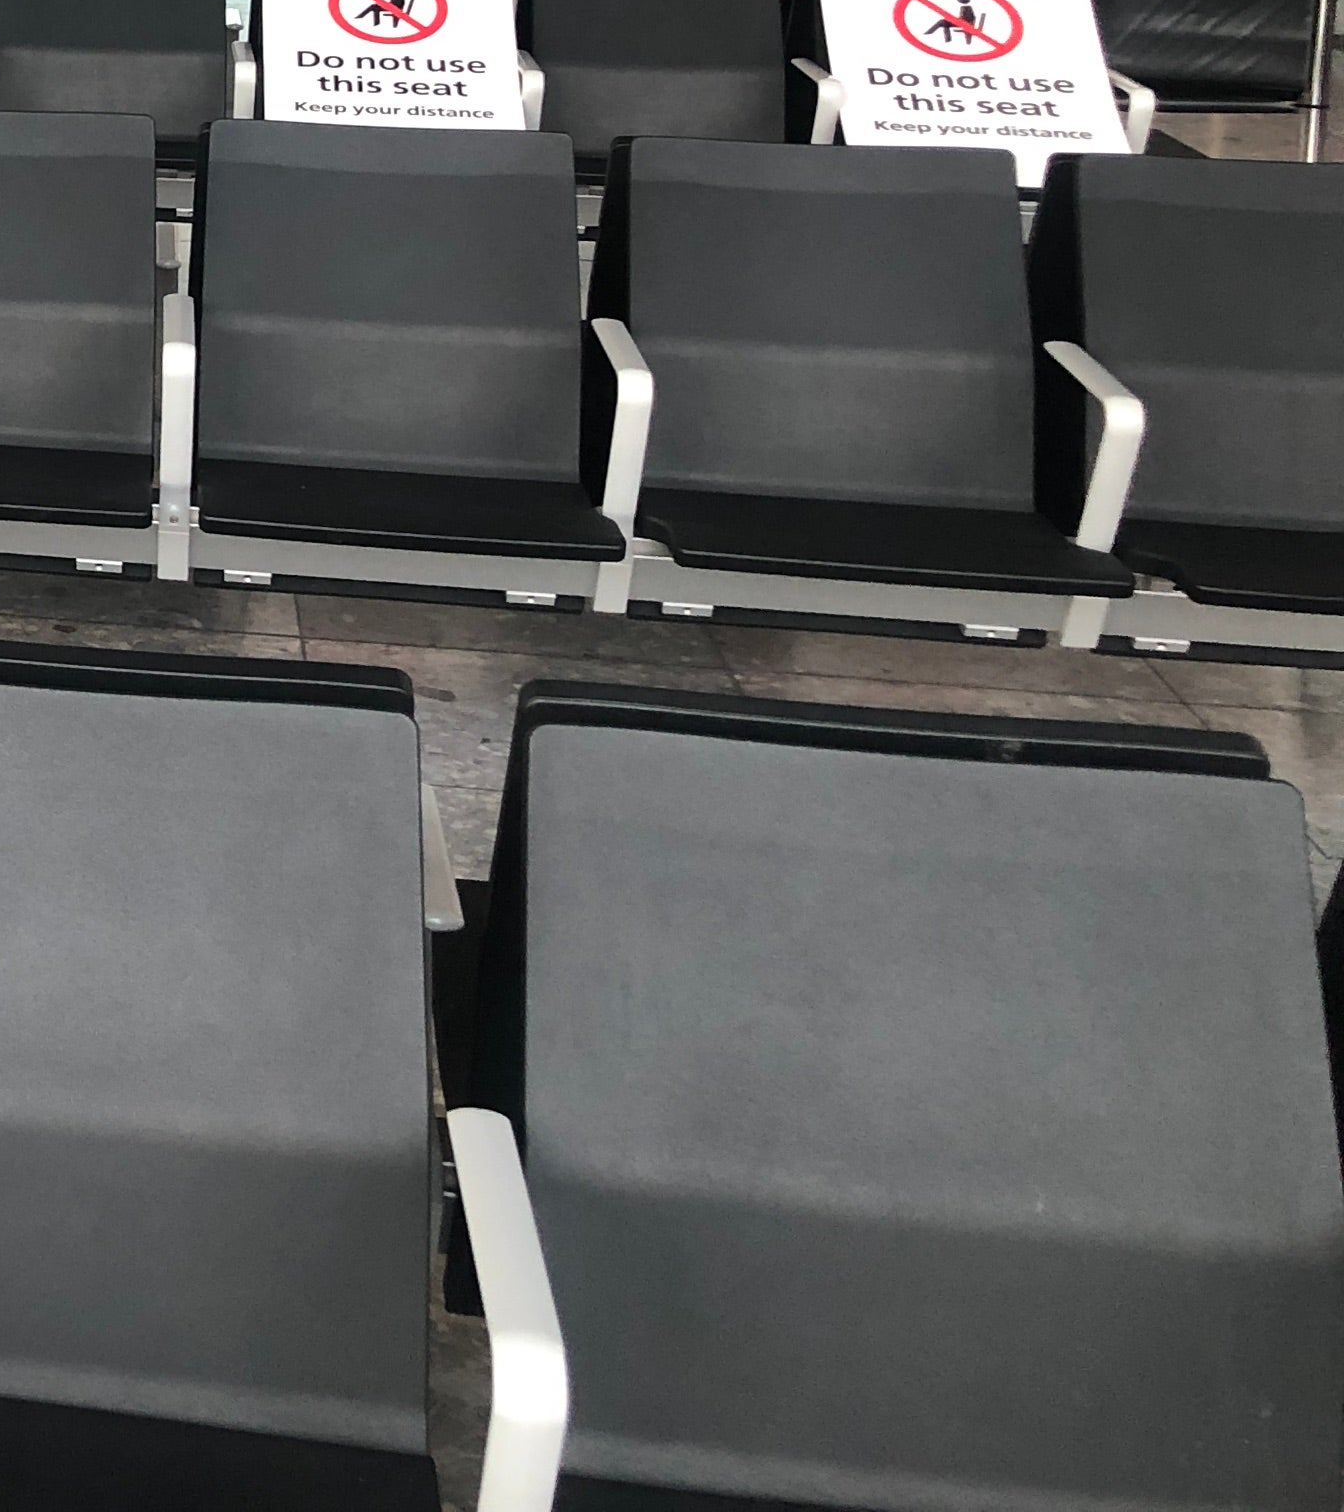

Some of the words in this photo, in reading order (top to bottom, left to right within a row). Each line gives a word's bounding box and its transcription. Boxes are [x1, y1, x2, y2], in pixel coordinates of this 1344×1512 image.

[297, 50, 344, 70] Do
[356, 55, 415, 71] not
[426, 58, 487, 74] use
[317, 75, 382, 94] this
[393, 80, 469, 97] seat
[867, 67, 919, 88] Do
[931, 71, 998, 91] not
[1008, 76, 1076, 94] use
[294, 101, 347, 116] Keep
[352, 104, 401, 117] your
[406, 105, 495, 119] distance
[893, 93, 966, 114] this
[976, 99, 1061, 118] seat
[874, 120, 932, 136] Keep
[937, 123, 990, 137] your
[996, 126, 1094, 140] distance
